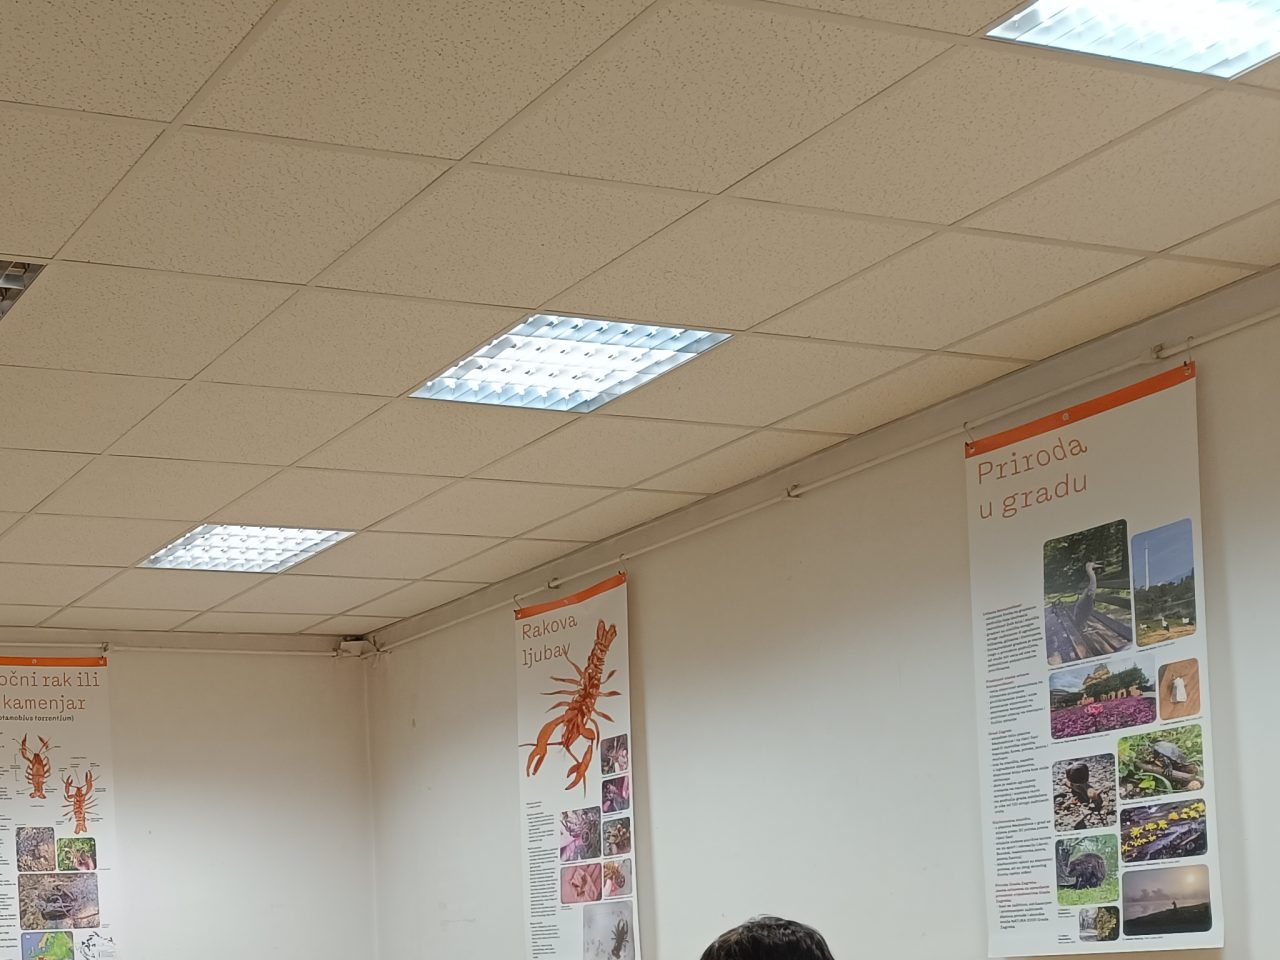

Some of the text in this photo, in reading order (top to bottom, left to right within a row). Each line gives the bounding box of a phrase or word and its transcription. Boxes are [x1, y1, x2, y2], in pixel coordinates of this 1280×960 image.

[978, 437, 1088, 485] Priroda
[979, 473, 1087, 519] u gradu
[522, 615, 578, 641] Rakova
[522, 642, 570, 669] ljubav
[42, 672, 72, 687] rak
[76, 671, 101, 687] ili
[3, 693, 86, 714] kamenjar
